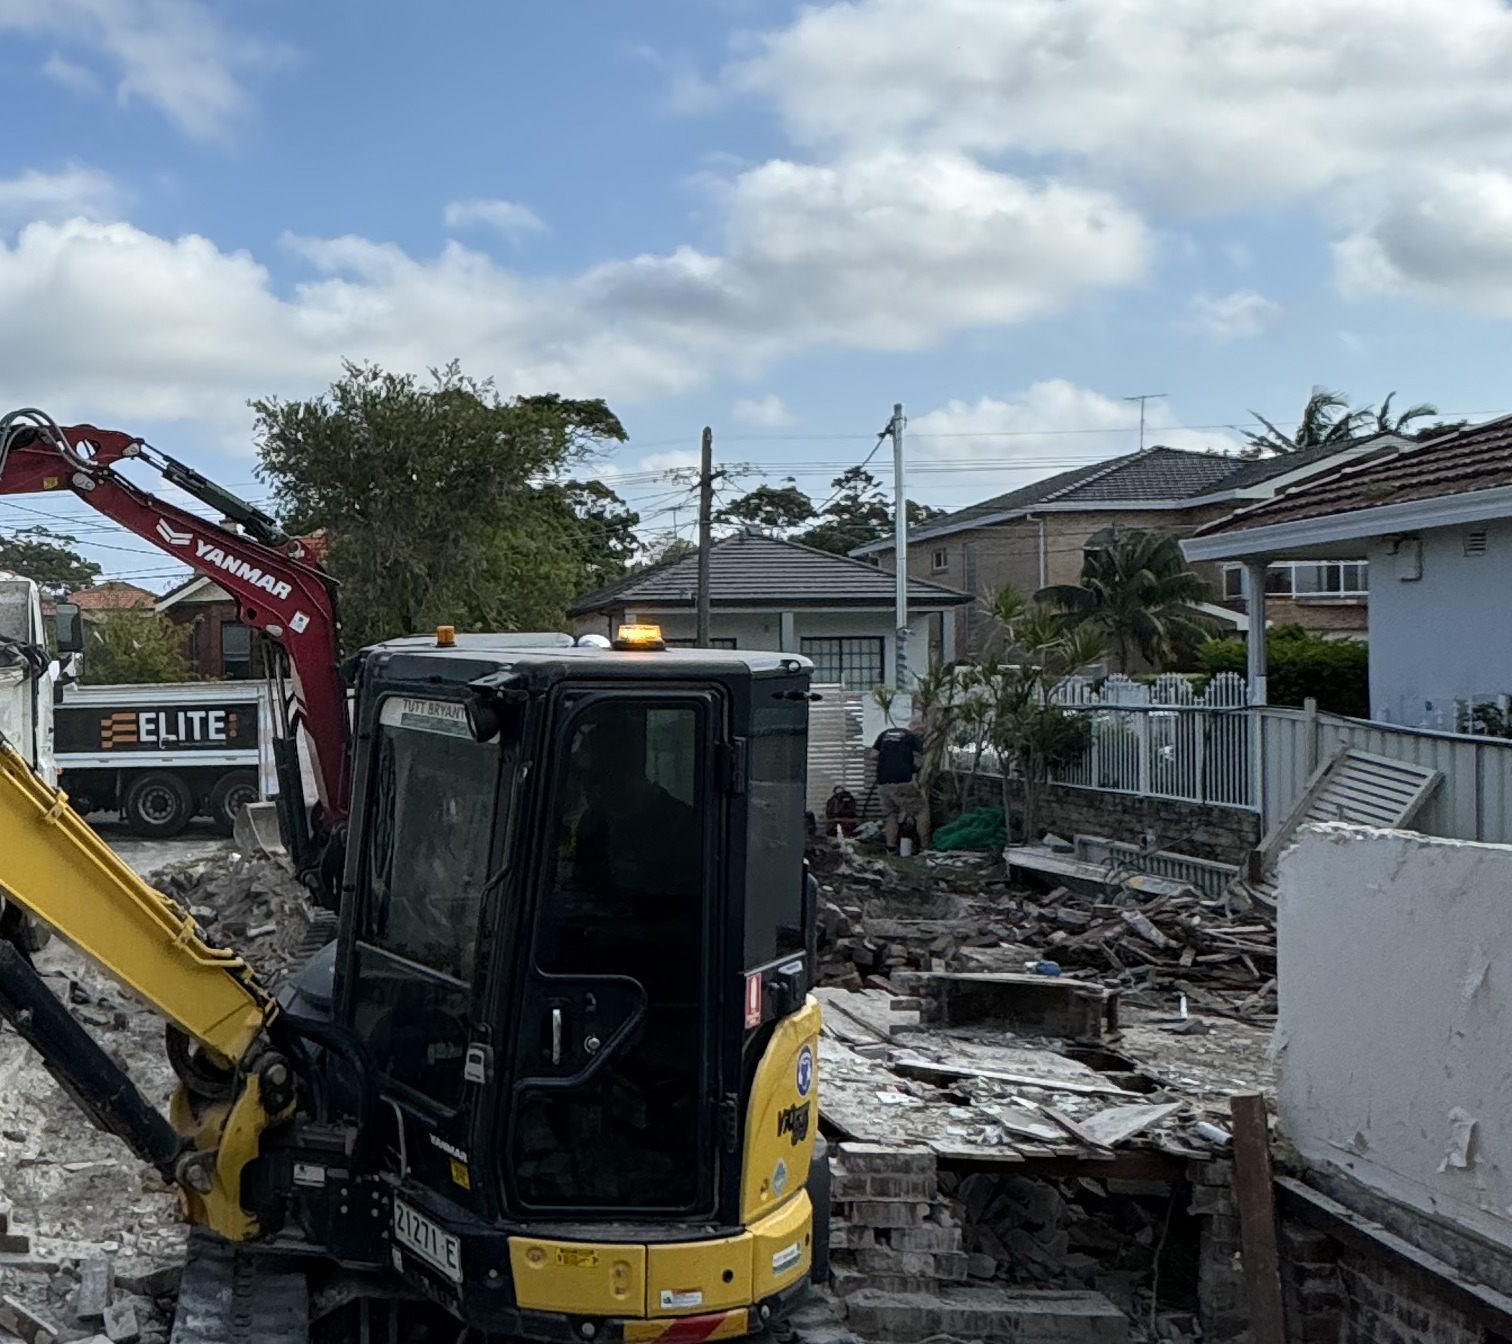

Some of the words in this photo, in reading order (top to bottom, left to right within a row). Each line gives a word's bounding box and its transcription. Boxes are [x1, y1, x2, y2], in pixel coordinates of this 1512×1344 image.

[195, 538, 292, 599] YANMAR
[403, 698, 425, 714] TUTT
[428, 702, 466, 720] BRYANT
[138, 710, 227, 742] ELITE
[428, 1132, 469, 1163] YANMAR
[396, 1203, 438, 1256] 21271
[445, 1236, 457, 1270] E
